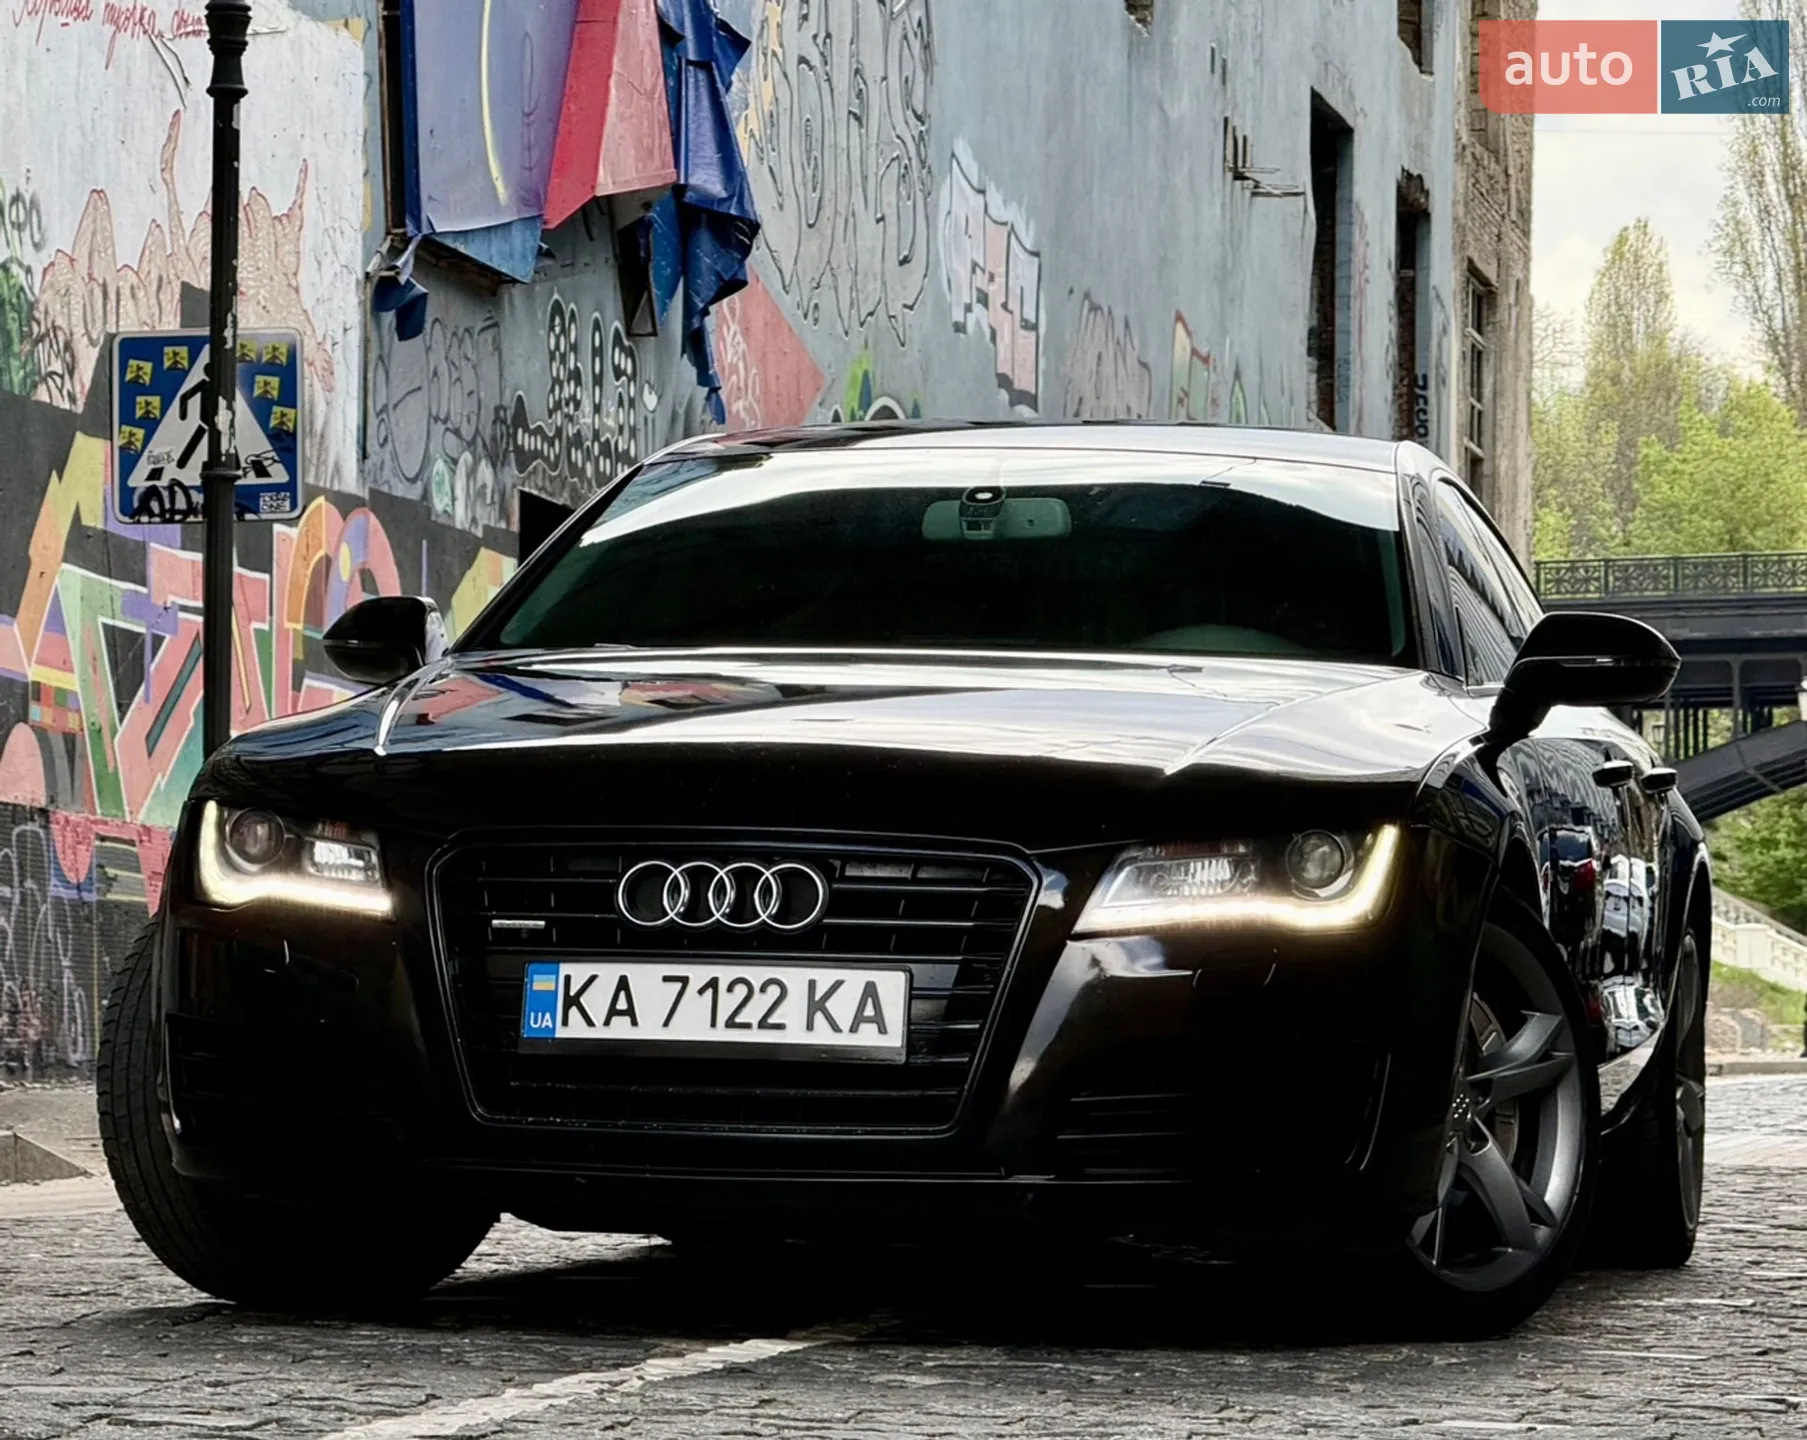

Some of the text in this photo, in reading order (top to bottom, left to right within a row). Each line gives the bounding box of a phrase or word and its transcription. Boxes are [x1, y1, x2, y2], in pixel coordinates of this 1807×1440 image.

[530, 1012, 553, 1029] UA
[561, 973, 889, 1034] KA 7122 KA
